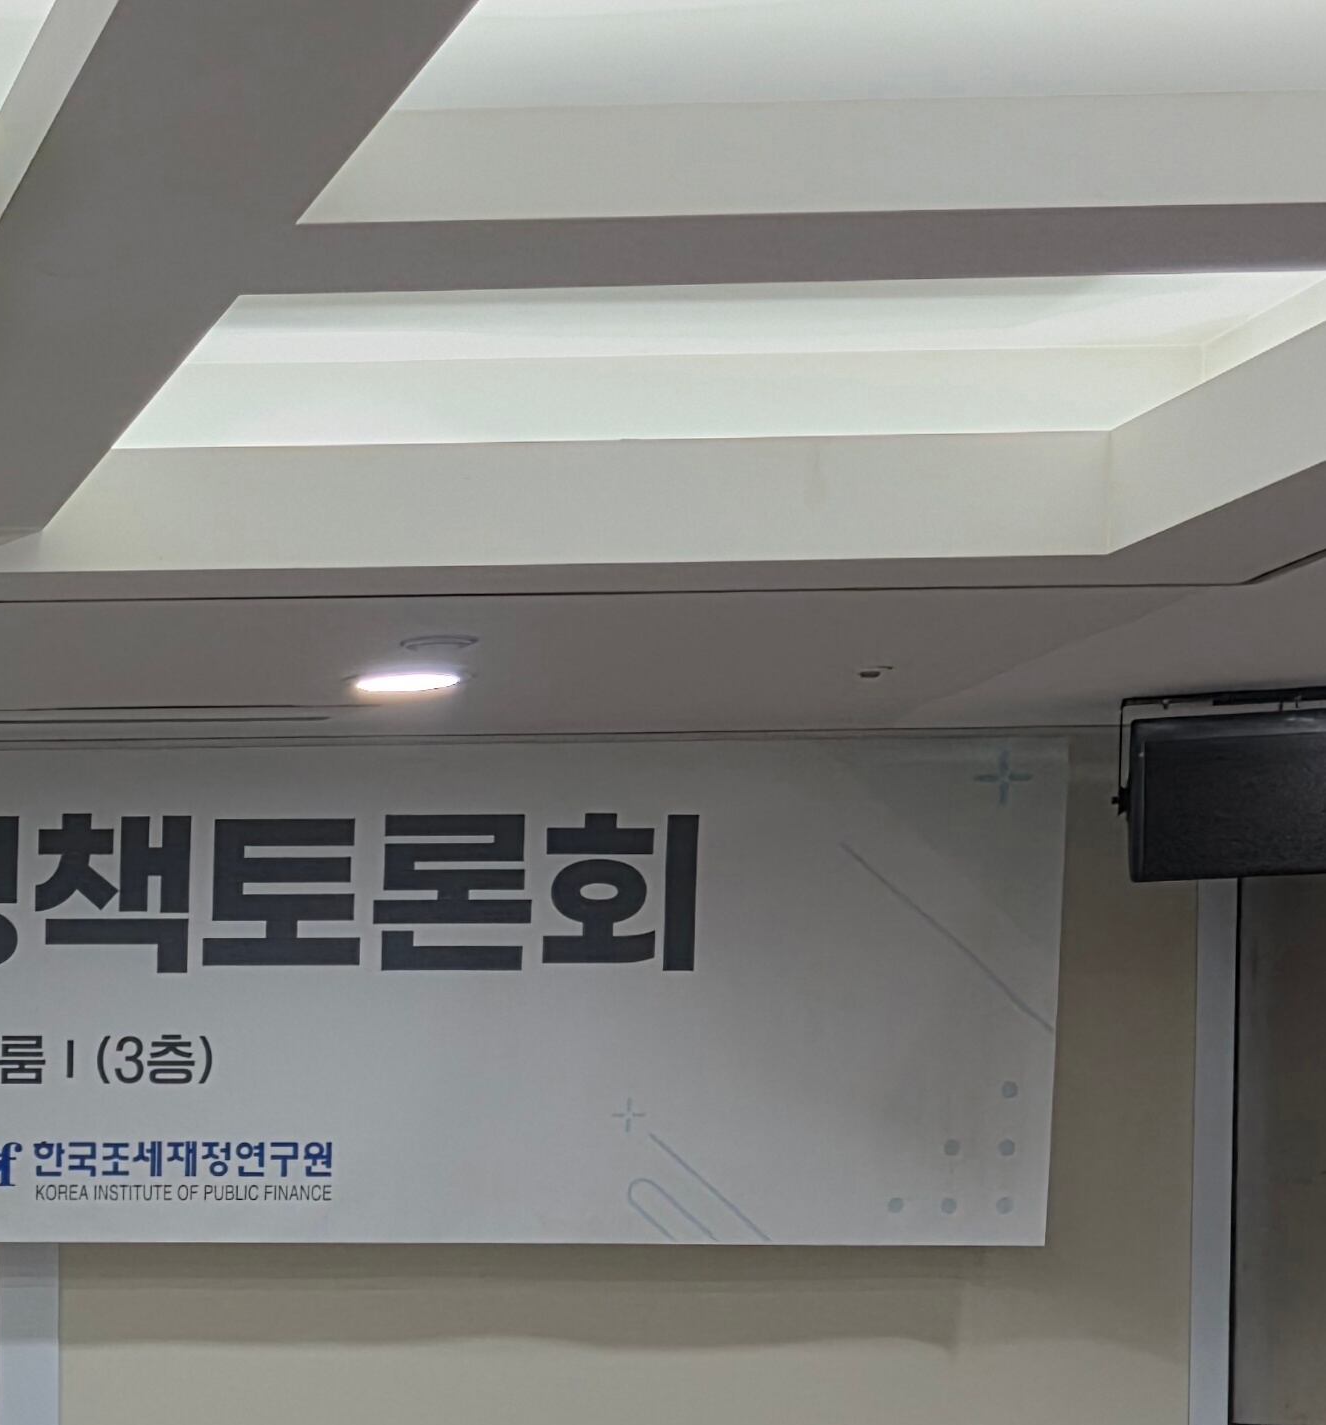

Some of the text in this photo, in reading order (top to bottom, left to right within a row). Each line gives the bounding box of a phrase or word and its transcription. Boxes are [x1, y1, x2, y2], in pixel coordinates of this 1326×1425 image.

[96, 1034, 213, 1085] (3층)
[33, 1140, 333, 1178] 한국조세재정연구원
[35, 1184, 332, 1202] KOREA INSTITUTE OF PUBLIC FINANCE
